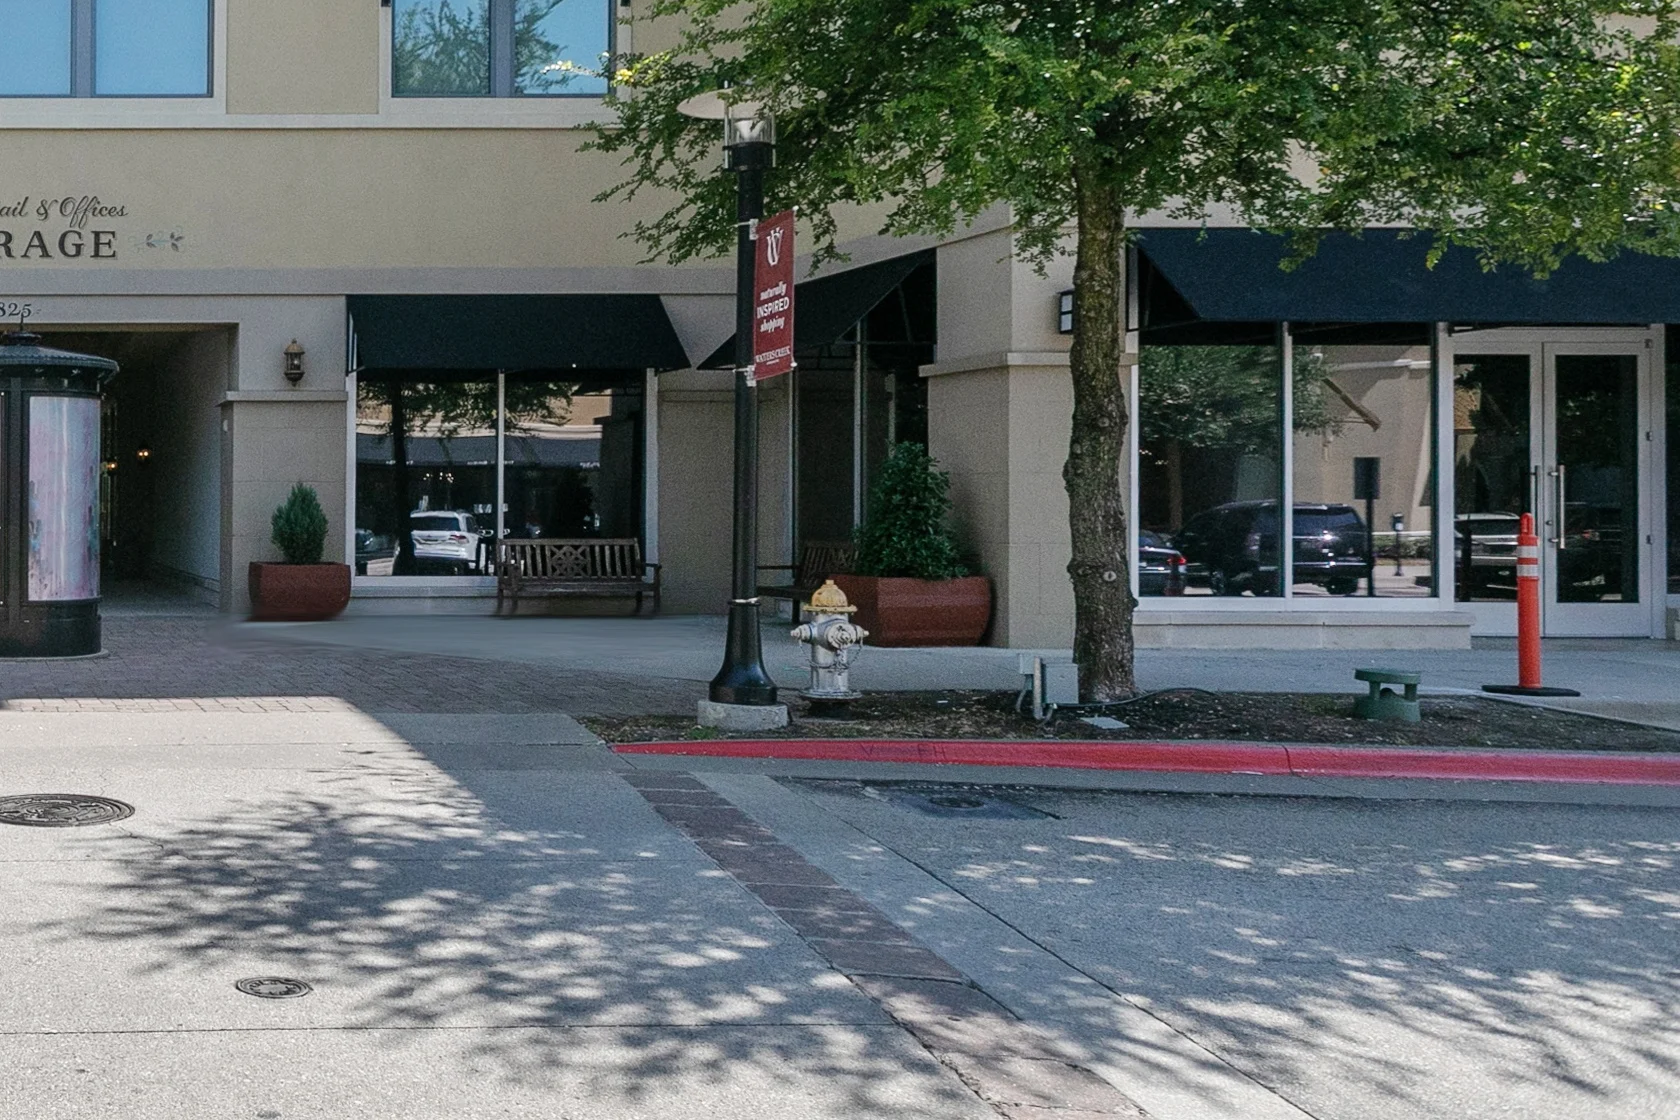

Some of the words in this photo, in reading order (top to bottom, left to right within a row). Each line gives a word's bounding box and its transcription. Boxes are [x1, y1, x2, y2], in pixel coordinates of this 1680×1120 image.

[36, 198, 59, 221] &
[59, 195, 130, 230] Offices
[760, 281, 787, 300] naturally
[757, 296, 790, 319] INSPIRED
[760, 316, 785, 333] shopping
